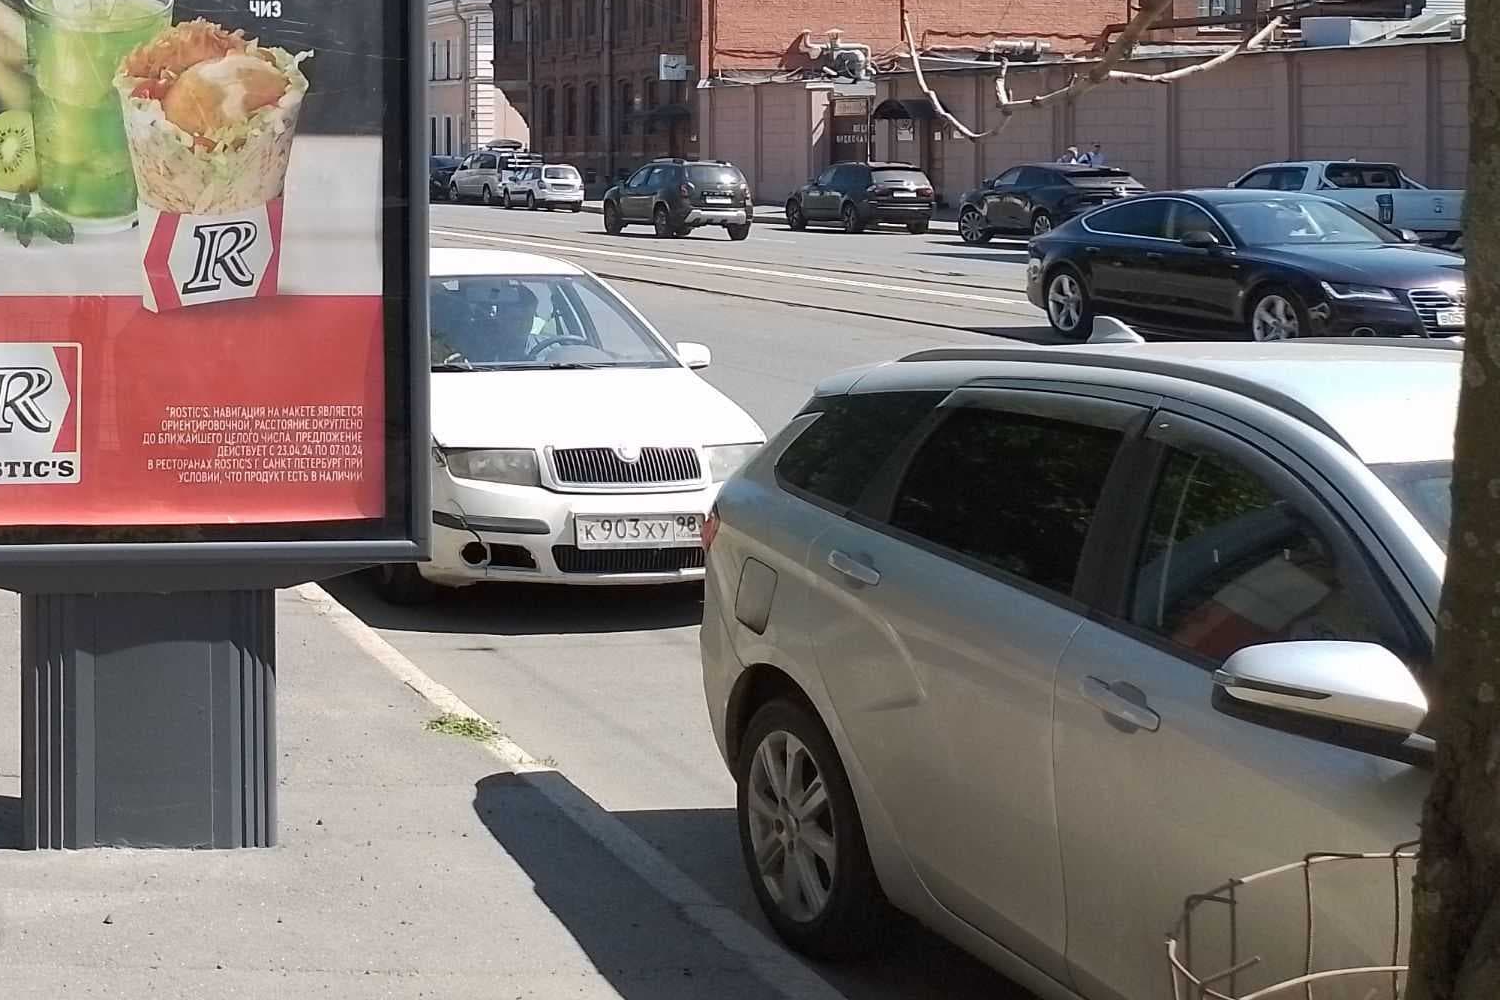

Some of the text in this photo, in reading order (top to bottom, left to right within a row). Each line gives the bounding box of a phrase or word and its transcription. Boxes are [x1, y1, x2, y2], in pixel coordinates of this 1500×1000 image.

[249, 0, 282, 18] ЧИЗ
[213, 406, 266, 419] НАВИГАЦИЯ
[267, 406, 280, 417] НА
[281, 405, 317, 417] МАКЕТЕ
[317, 405, 363, 417] ЯВЛЯЕТСЯ
[254, 418, 312, 430] РАССТОЯНИЕ
[312, 418, 363, 430] ОКРУГЛЕНО
[142, 432, 156, 445] ДО
[158, 432, 222, 444] БЛИЖАЙШЕГО
[224, 432, 259, 445] ЦЕЛОГО
[296, 431, 363, 443] ПРЕДЛОЖЕНИЕ
[217, 445, 267, 457] ДЕЙСТВУЕТ
[269, 445, 275, 456] С
[315, 444, 328, 456] ПО
[147, 459, 154, 470] В
[156, 459, 212, 470] РЕСТОРАНАХ
[344, 457, 363, 469] ПРИ
[224, 471, 243, 482] ЧТО
[244, 470, 286, 483] ПРОДУКТ
[287, 470, 309, 482] ЕСТЬ
[311, 470, 317, 482] В
[319, 470, 363, 482] НАЛИЧИИ
